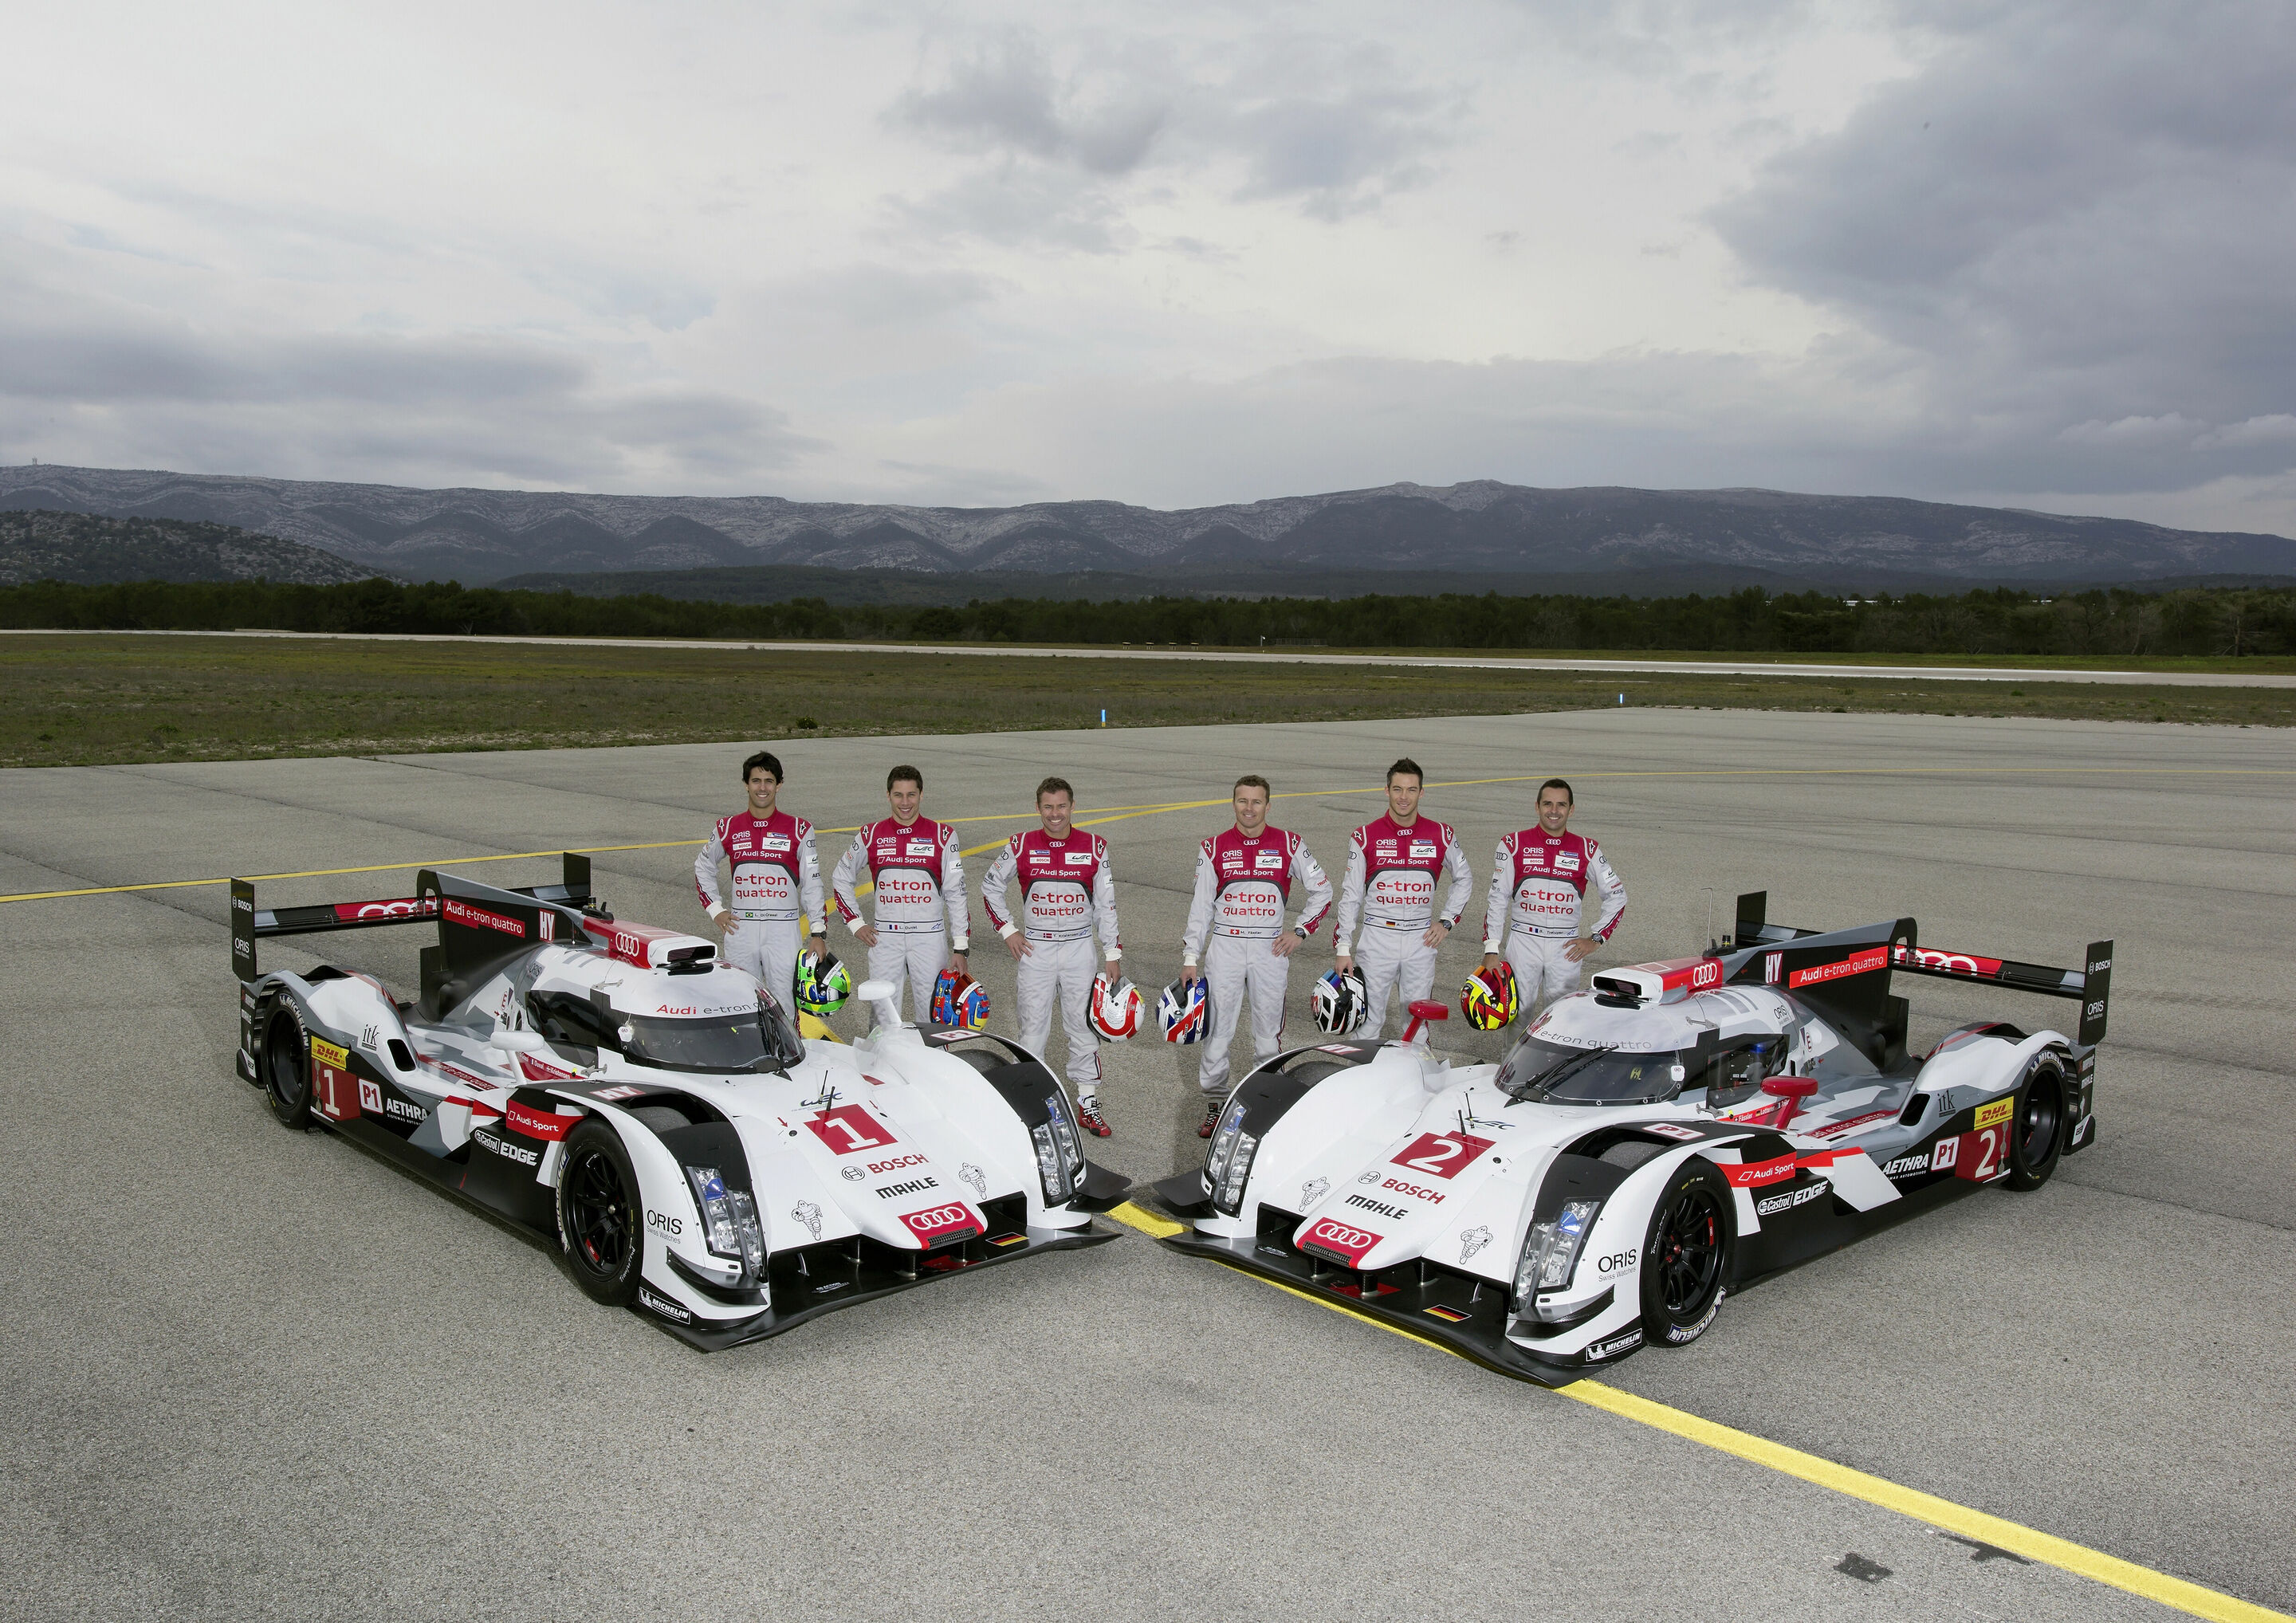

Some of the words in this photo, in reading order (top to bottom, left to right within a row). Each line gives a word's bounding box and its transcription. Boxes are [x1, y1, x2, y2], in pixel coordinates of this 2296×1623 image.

[732, 831, 751, 839] ORIS
[735, 874, 787, 886] e-tron
[879, 879, 932, 890] e-tron
[1376, 881, 1432, 892] e-tron
[736, 888, 788, 899] quattro
[879, 894, 931, 905] quattro
[1032, 893, 1085, 903] e-tron
[1225, 891, 1276, 903] e-tron
[1376, 895, 1430, 905] quattro
[1520, 889, 1575, 902] e-tron
[238, 899, 252, 912] BOSCH
[1032, 906, 1084, 917] quattro
[1223, 906, 1276, 917] quattro
[1520, 902, 1574, 914] quattro
[446, 902, 465, 917] Audi
[466, 909, 490, 925] e-tron
[491, 916, 522, 934] quattro
[540, 910, 555, 941] HY
[234, 937, 250, 953] ORIS
[1766, 953, 1783, 983] HY
[1800, 967, 1822, 983] Audi
[1824, 963, 1850, 977] e-tron
[1852, 955, 1884, 973] quattro
[2095, 959, 2111, 972] BOSCH
[656, 1004, 697, 1015] Audi
[703, 1003, 751, 1014] e-tron
[1774, 1004, 1787, 1020] ORIS
[2087, 1000, 2104, 1015] ORIS
[286, 996, 309, 1050] MICHELIN
[362, 1024, 379, 1046] itk
[1540, 1029, 1582, 1045] e-tron
[1587, 1039, 1652, 1050] quattro
[316, 1043, 340, 1063] DHL
[324, 1069, 340, 1116] 1
[363, 1084, 379, 1108] P1
[592, 1086, 639, 1100] HY
[1937, 1089, 1956, 1112] itk
[387, 1098, 428, 1121] AETHRA
[1980, 1104, 2007, 1122] DHL
[516, 1115, 532, 1126] Audi
[533, 1120, 559, 1132] Sport
[824, 1117, 880, 1149] 1
[1655, 1126, 1693, 1137] P1
[480, 1134, 498, 1151] Castrol
[500, 1142, 539, 1166] EDGE
[1406, 1138, 1463, 1173] 2
[1936, 1142, 1955, 1165] P1
[1975, 1129, 1996, 1178] 2
[867, 1153, 930, 1174] BOSCH
[1754, 1167, 1773, 1179] Audi
[1775, 1162, 1795, 1175] Sport
[1882, 1153, 1929, 1175] AETHRA
[875, 1177, 939, 1199] MAHLE
[1381, 1178, 1446, 1205] BOSCH
[1767, 1196, 1791, 1211] Castrol
[1793, 1180, 1828, 1206] EDGE
[1345, 1194, 1409, 1220] MAHLE
[647, 1209, 682, 1235] ORIS
[647, 1225, 659, 1236] Swiss
[659, 1230, 681, 1244] Watches
[1598, 1248, 1637, 1273] ORIS
[1598, 1271, 1615, 1283] Swiss
[1615, 1266, 1637, 1279] Watches
[652, 1298, 689, 1319] MICHELIN
[1605, 1332, 1641, 1352] MICHELIN
